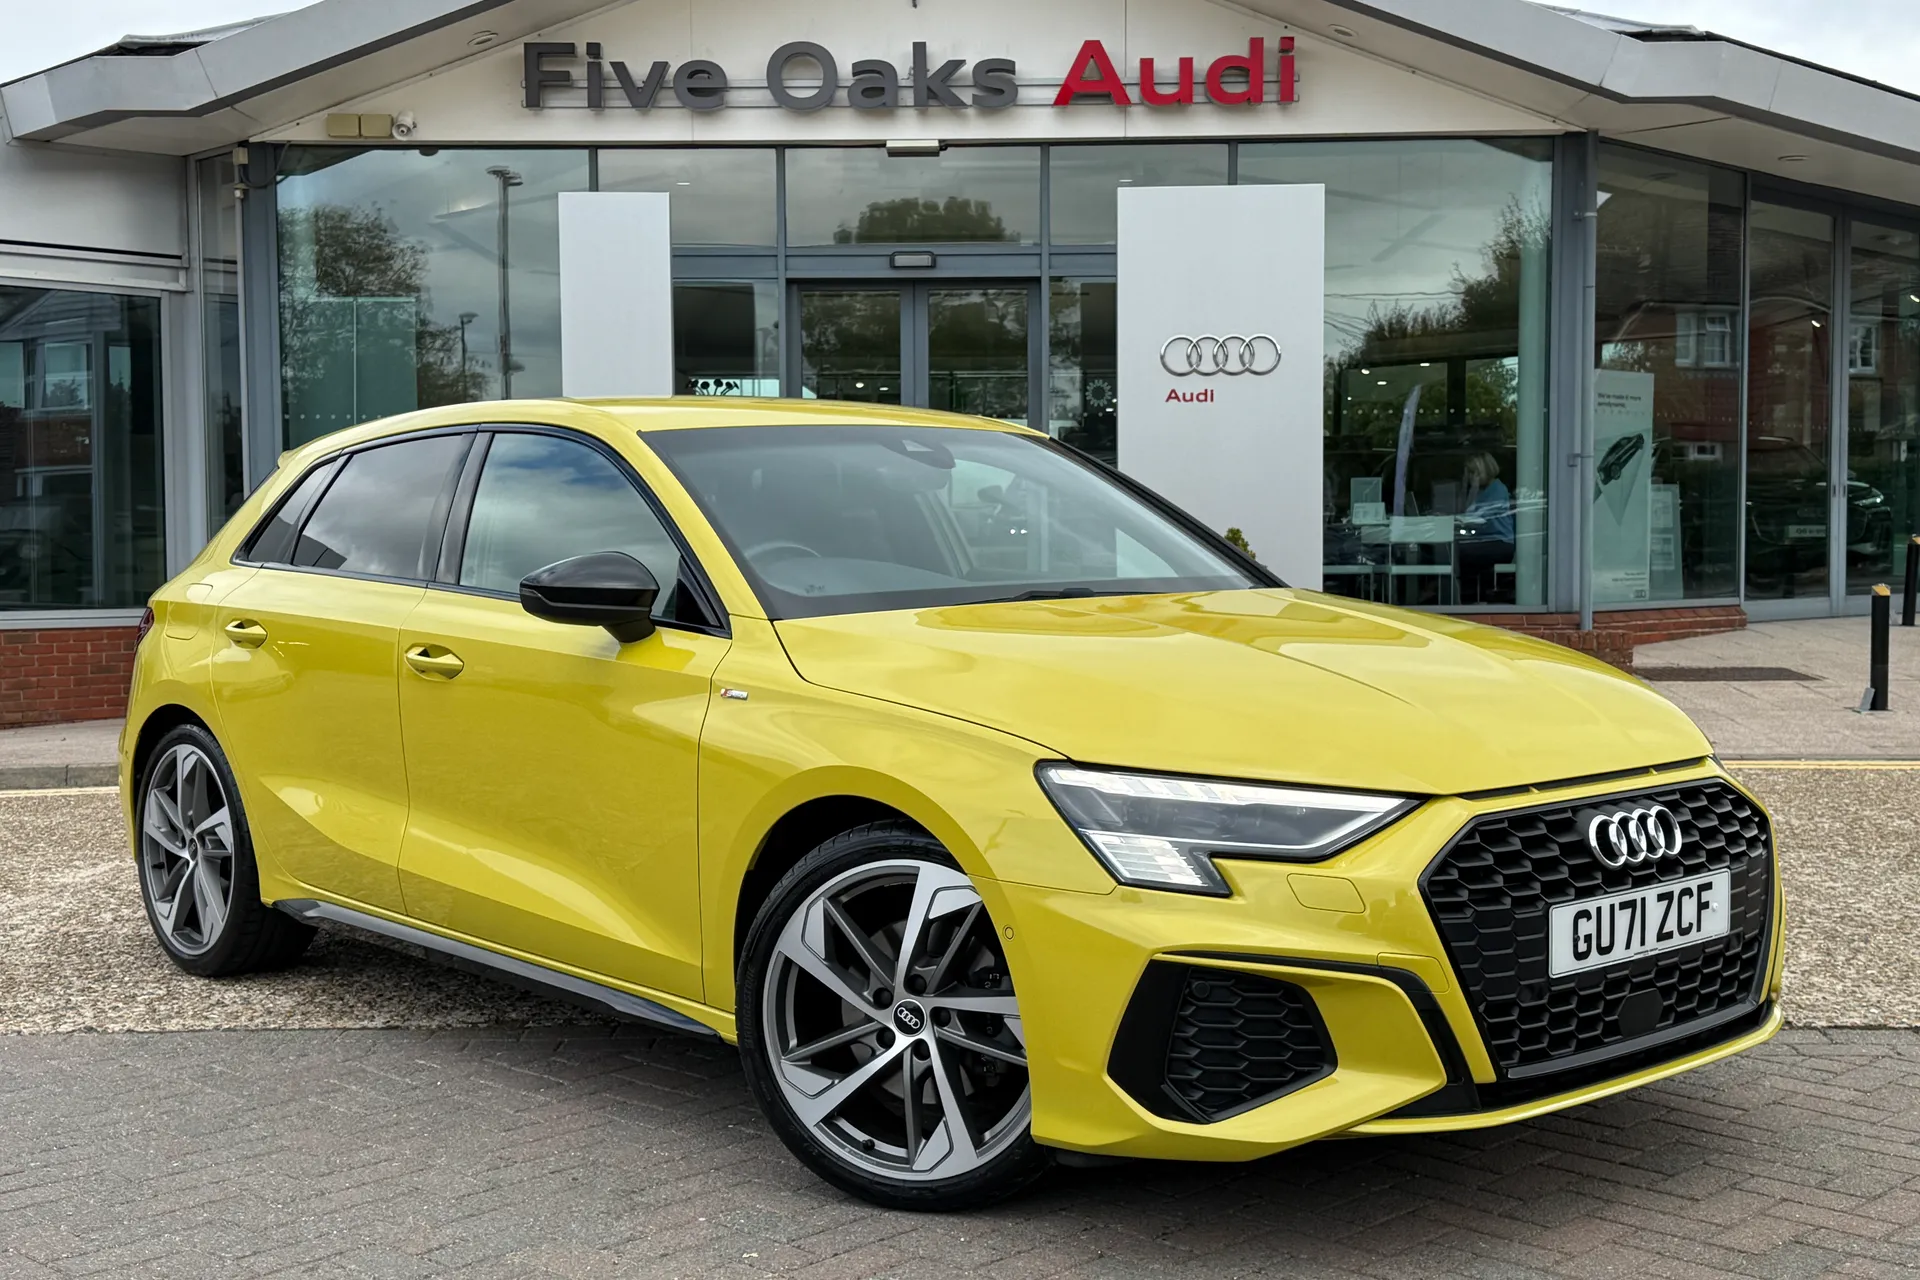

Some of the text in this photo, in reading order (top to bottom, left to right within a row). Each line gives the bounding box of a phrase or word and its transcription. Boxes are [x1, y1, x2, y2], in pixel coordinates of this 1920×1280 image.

[523, 37, 1298, 110] Five Oaks Audi
[1165, 388, 1215, 403] Audi
[1572, 881, 1713, 961] GU71 ZCF
